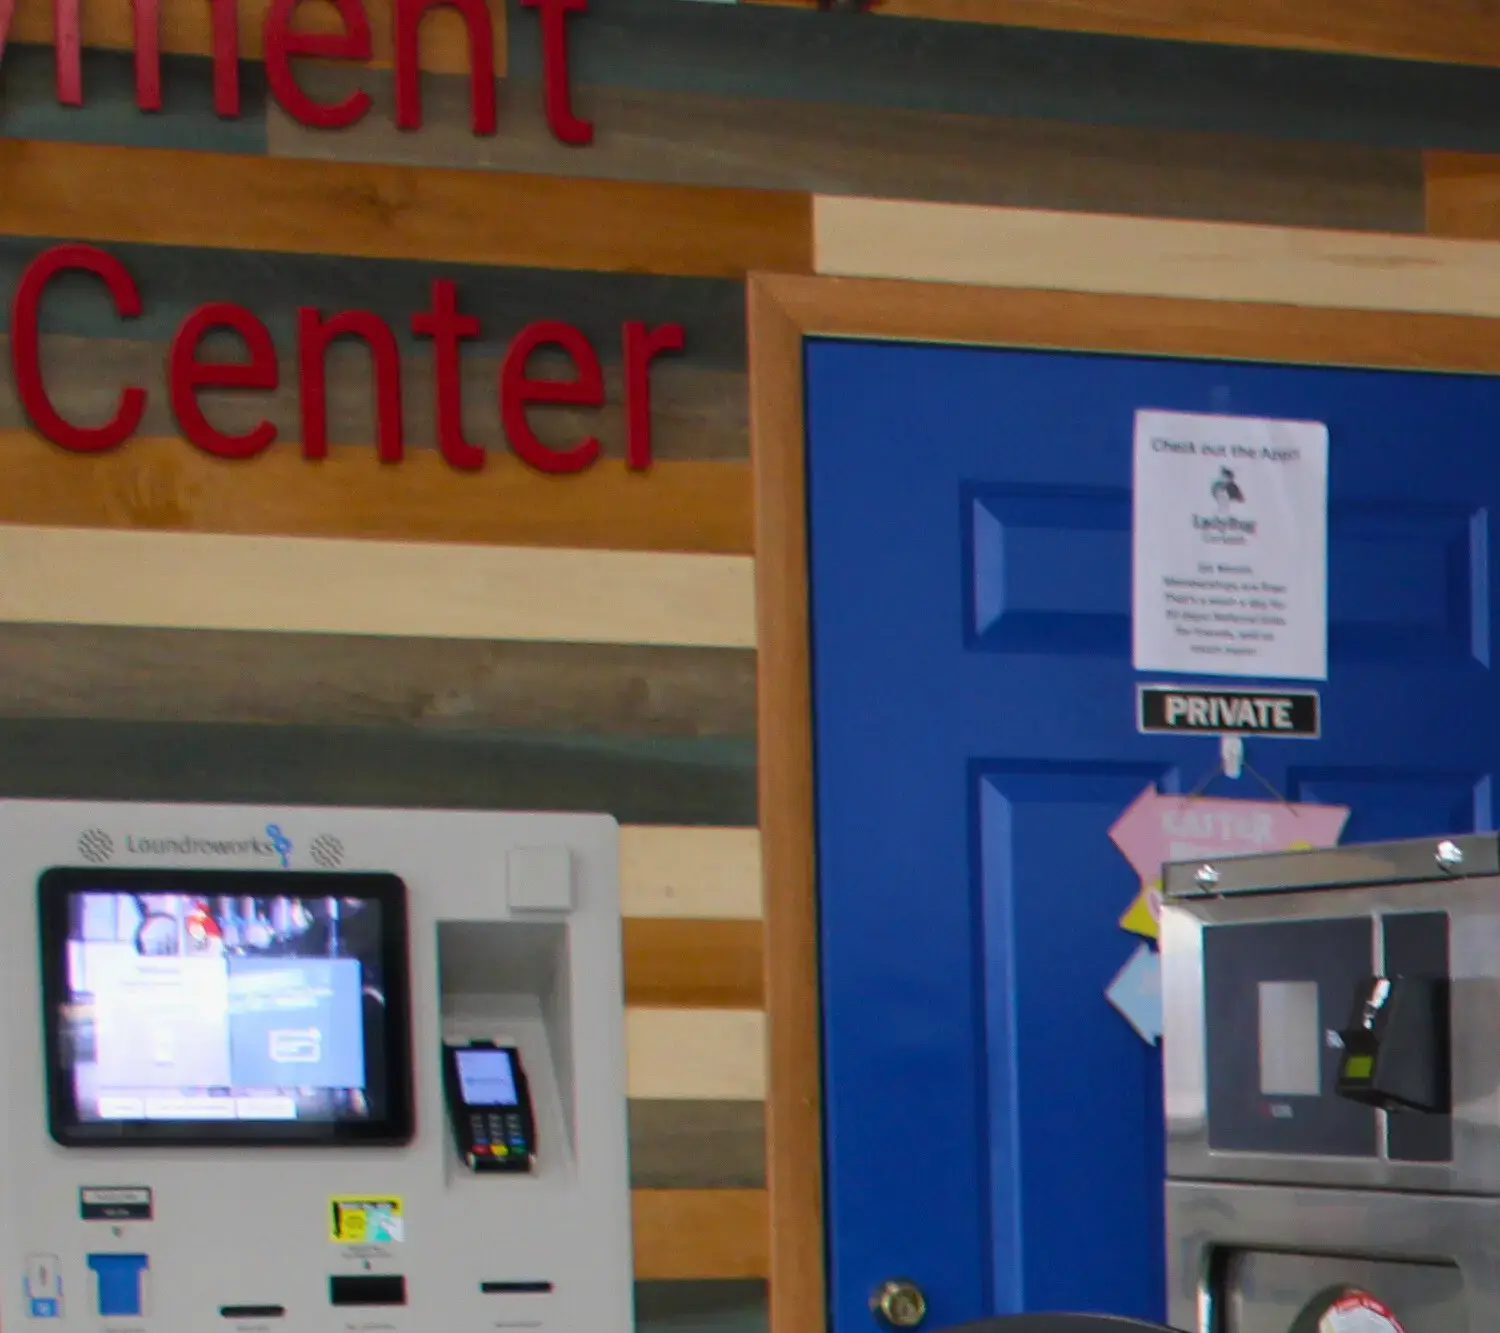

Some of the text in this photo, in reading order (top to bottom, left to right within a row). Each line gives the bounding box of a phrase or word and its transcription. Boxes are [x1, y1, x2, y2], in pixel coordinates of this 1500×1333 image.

[0, 0, 595, 146] ment
[11, 242, 685, 474] Center
[1150, 436, 1196, 455] Check
[1230, 442, 1259, 460] the
[1165, 695, 1294, 730] PRIVATE
